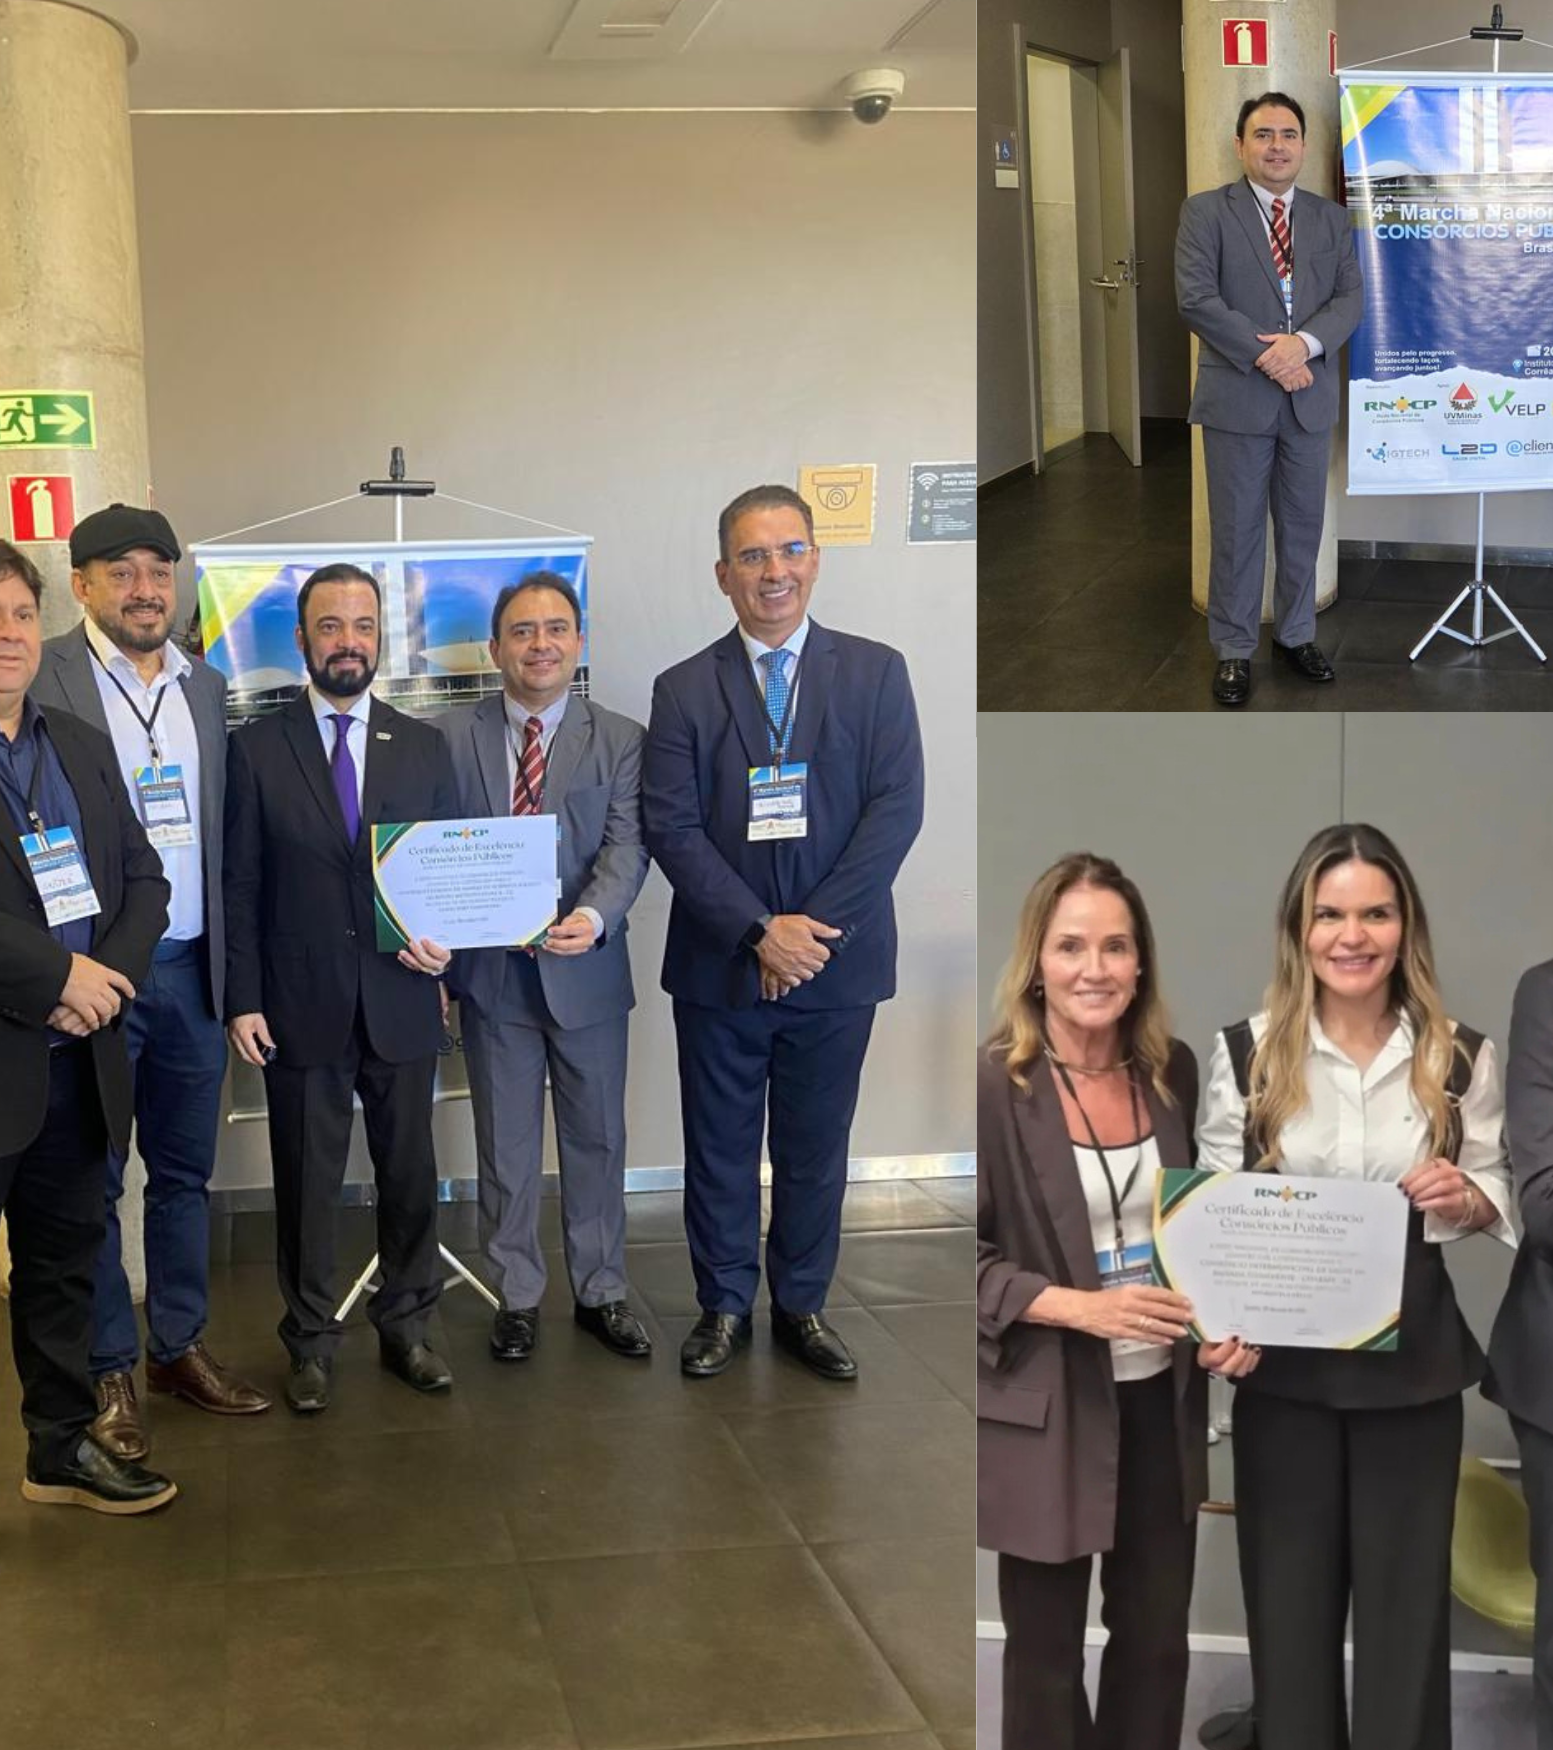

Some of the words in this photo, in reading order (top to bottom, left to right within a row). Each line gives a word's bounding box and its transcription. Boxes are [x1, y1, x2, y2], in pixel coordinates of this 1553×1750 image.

[1400, 203, 1479, 221] Marcha
[1373, 220, 1509, 240] CONSÓRCIOS
[1401, 350, 1418, 358] pelo
[1504, 403, 1546, 416] VELP
[1204, 1202, 1276, 1218] Certificado
